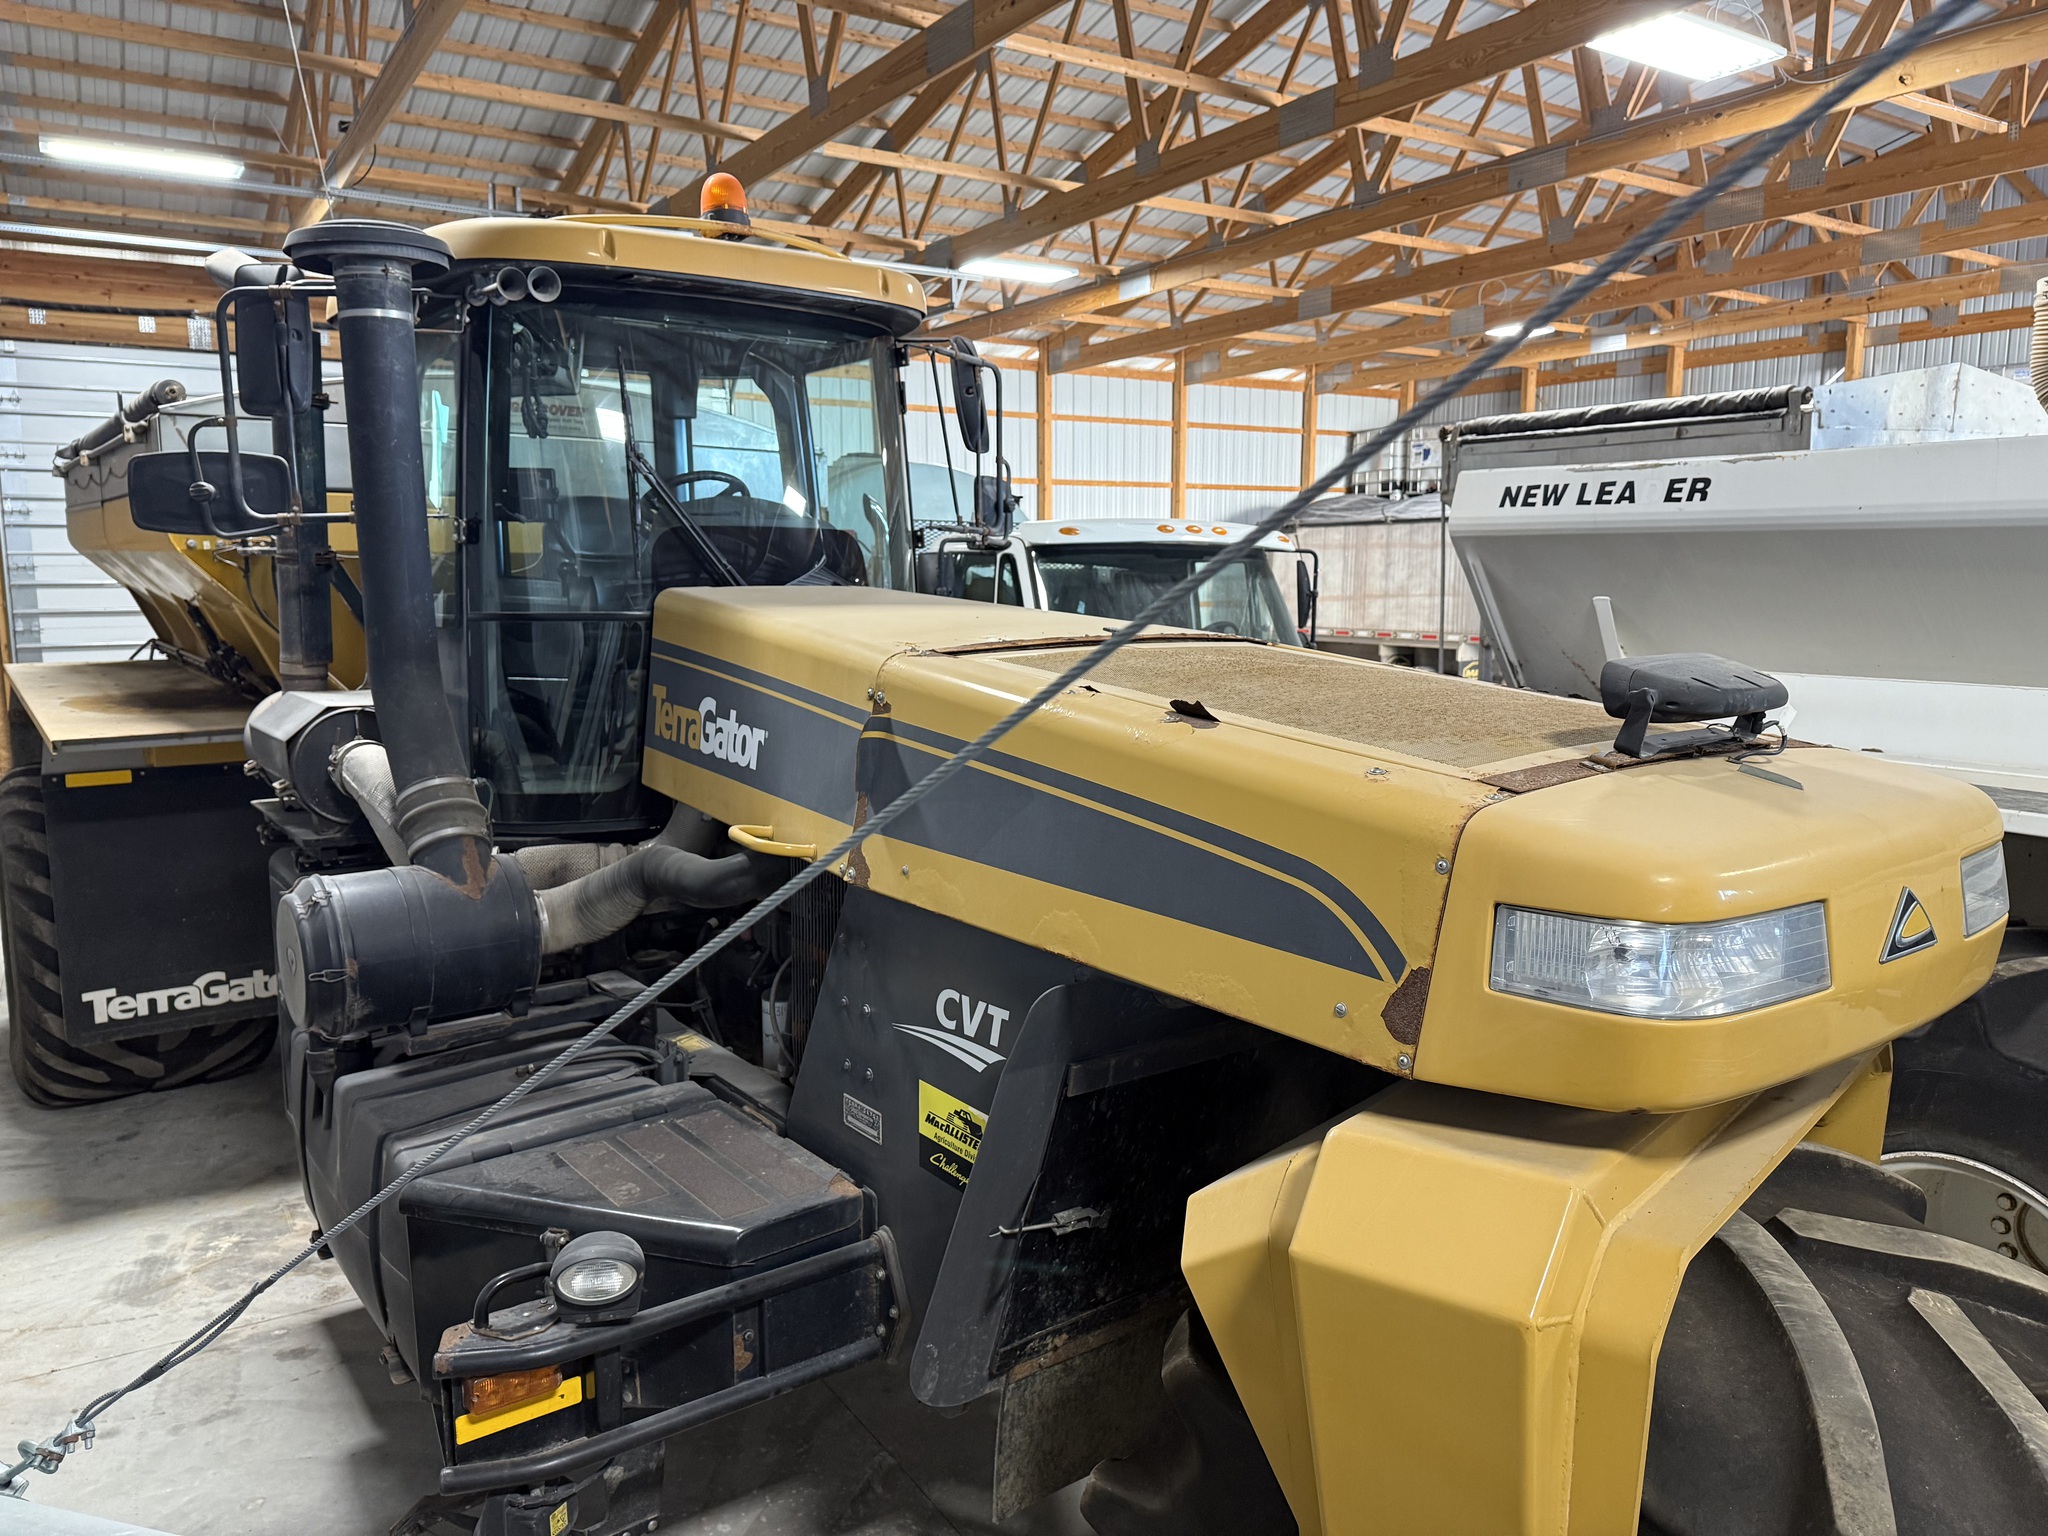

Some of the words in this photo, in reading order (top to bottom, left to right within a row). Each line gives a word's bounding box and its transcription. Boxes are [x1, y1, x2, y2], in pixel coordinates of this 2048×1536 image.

[1499, 483, 1569, 508] NEW
[1576, 477, 1712, 506] LEAER
[652, 684, 766, 770] TerraGator
[935, 988, 1010, 1047] CVT
[925, 1113, 980, 1150] MacALLISTE
[934, 1132, 964, 1155] Agriculture
[965, 1148, 976, 1162] Divi
